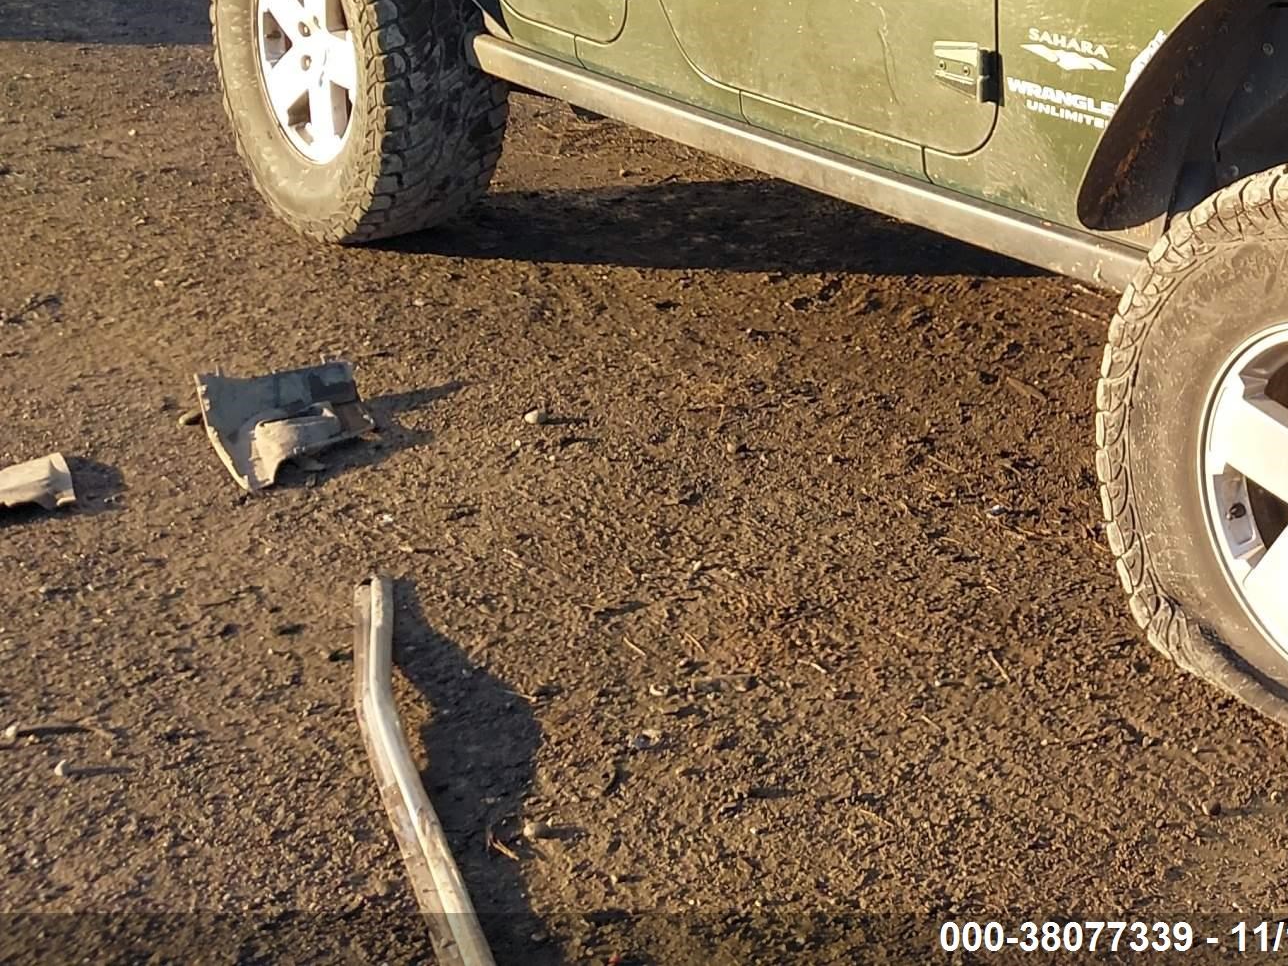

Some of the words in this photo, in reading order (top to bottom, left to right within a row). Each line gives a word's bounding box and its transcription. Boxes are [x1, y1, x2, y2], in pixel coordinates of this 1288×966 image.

[1027, 27, 1110, 59] SAHARA
[1006, 76, 1118, 118] WRANGLE
[1025, 99, 1110, 129] UNLIMITE
